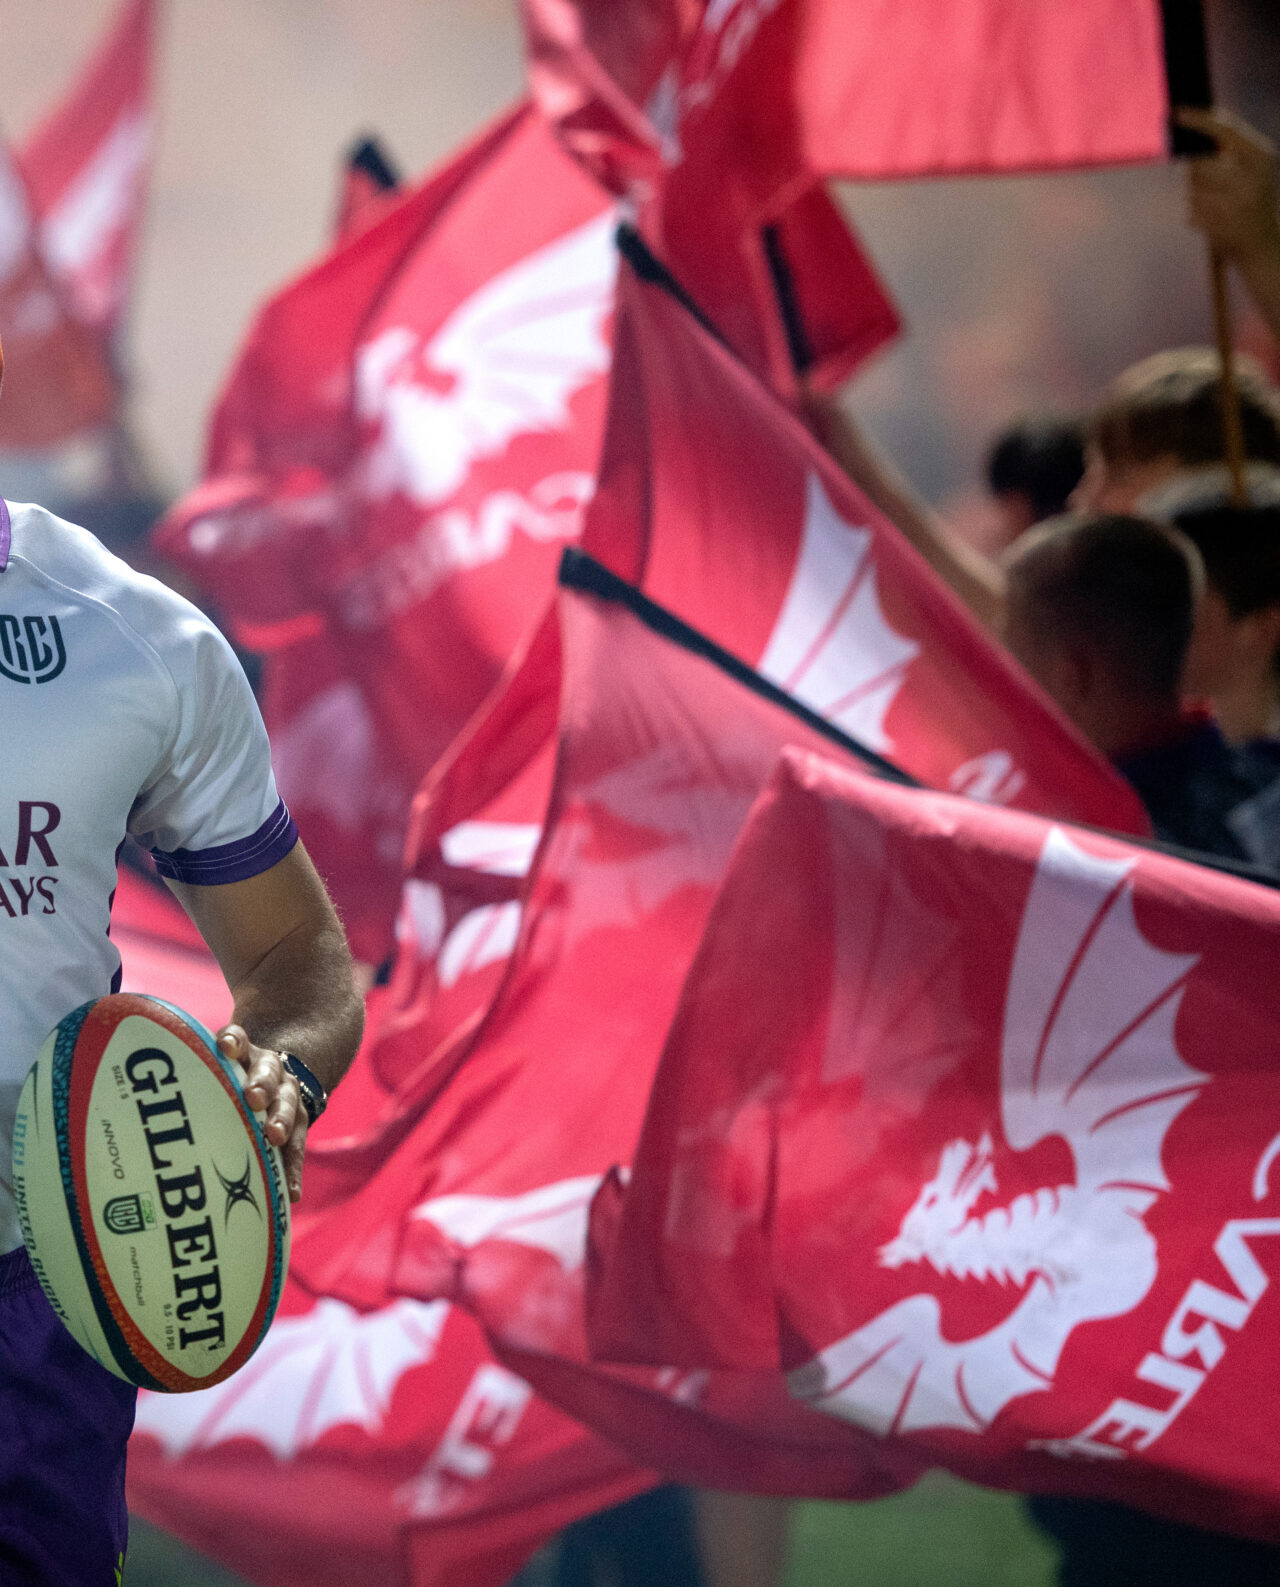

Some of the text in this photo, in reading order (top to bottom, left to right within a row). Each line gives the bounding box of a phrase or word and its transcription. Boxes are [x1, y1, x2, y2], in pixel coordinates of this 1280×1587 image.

[111, 1064, 125, 1086] SIZE
[16, 1175, 69, 1320] UNITED RUGBY
[124, 1047, 227, 1352] GILBERT
[130, 1246, 145, 1306] matchball
